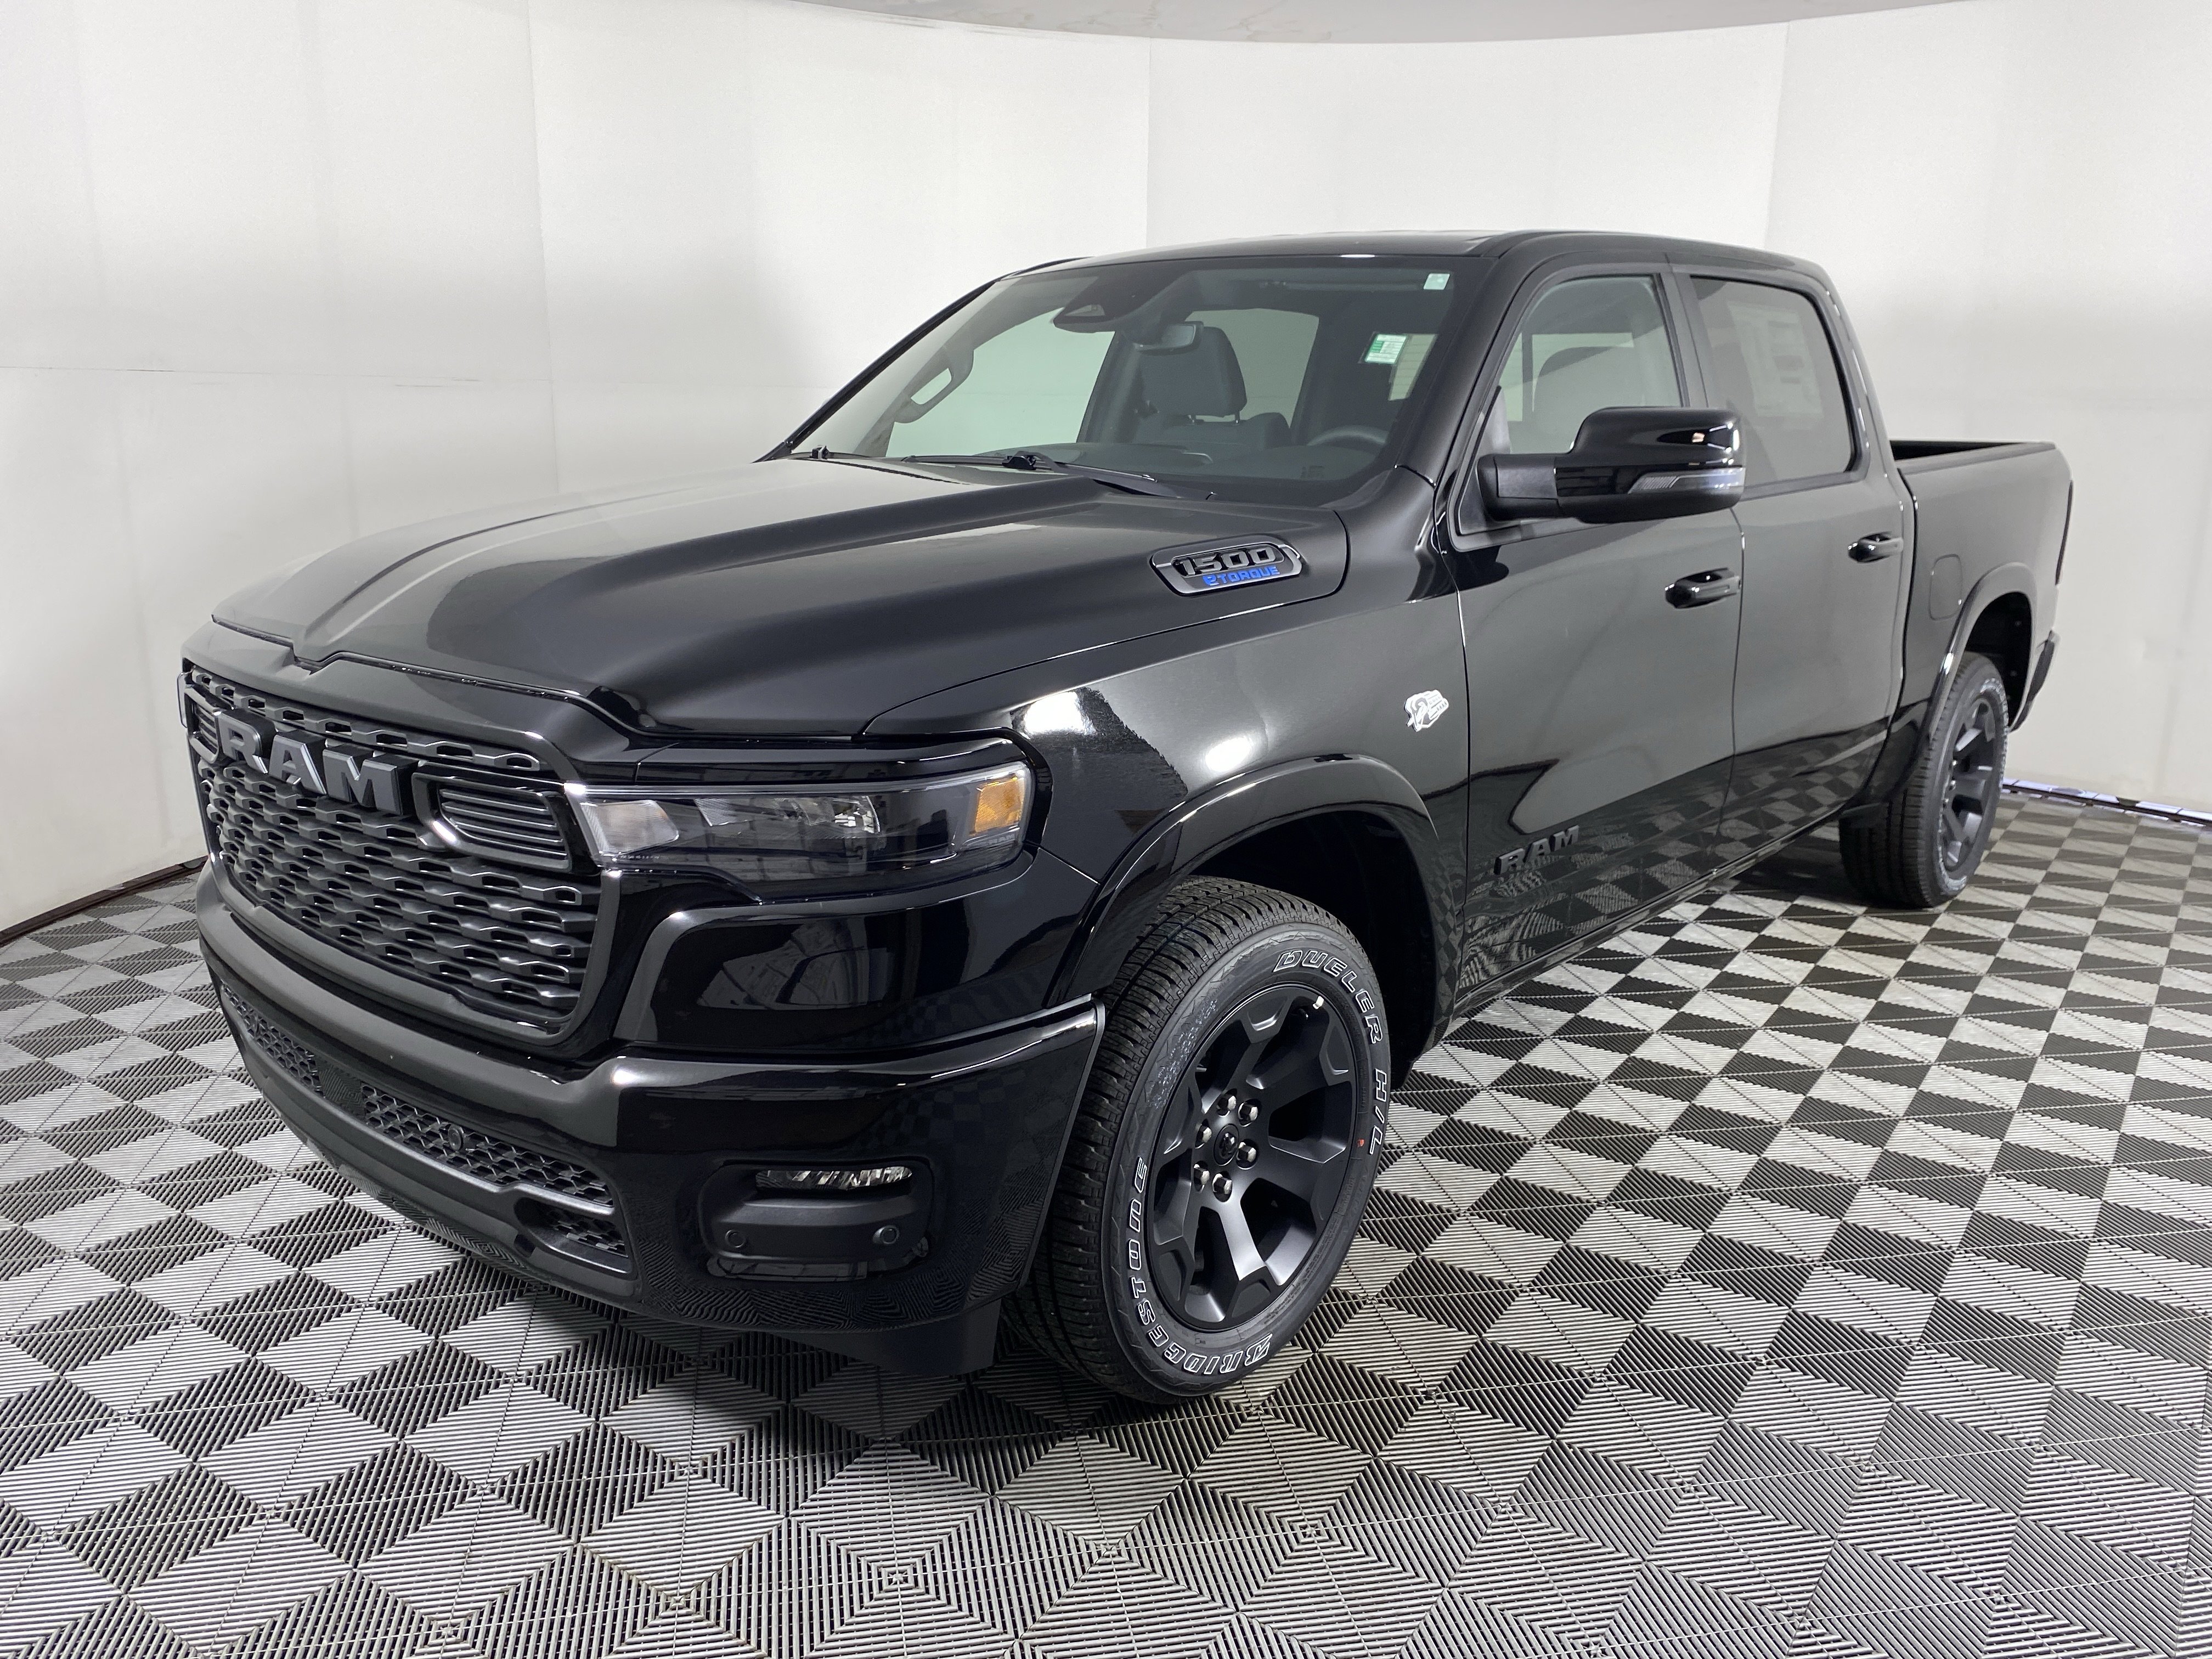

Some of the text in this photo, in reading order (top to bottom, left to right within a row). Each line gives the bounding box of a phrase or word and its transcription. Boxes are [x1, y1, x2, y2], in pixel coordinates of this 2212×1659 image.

[1179, 548, 1276, 575] 1500
[219, 712, 406, 816] RAM
[1494, 825, 1579, 875] RAM
[1273, 950, 1383, 1043] DUELER
[1369, 1068, 1387, 1155] H/L
[1128, 1157, 1273, 1375] BRIDGESTONE
